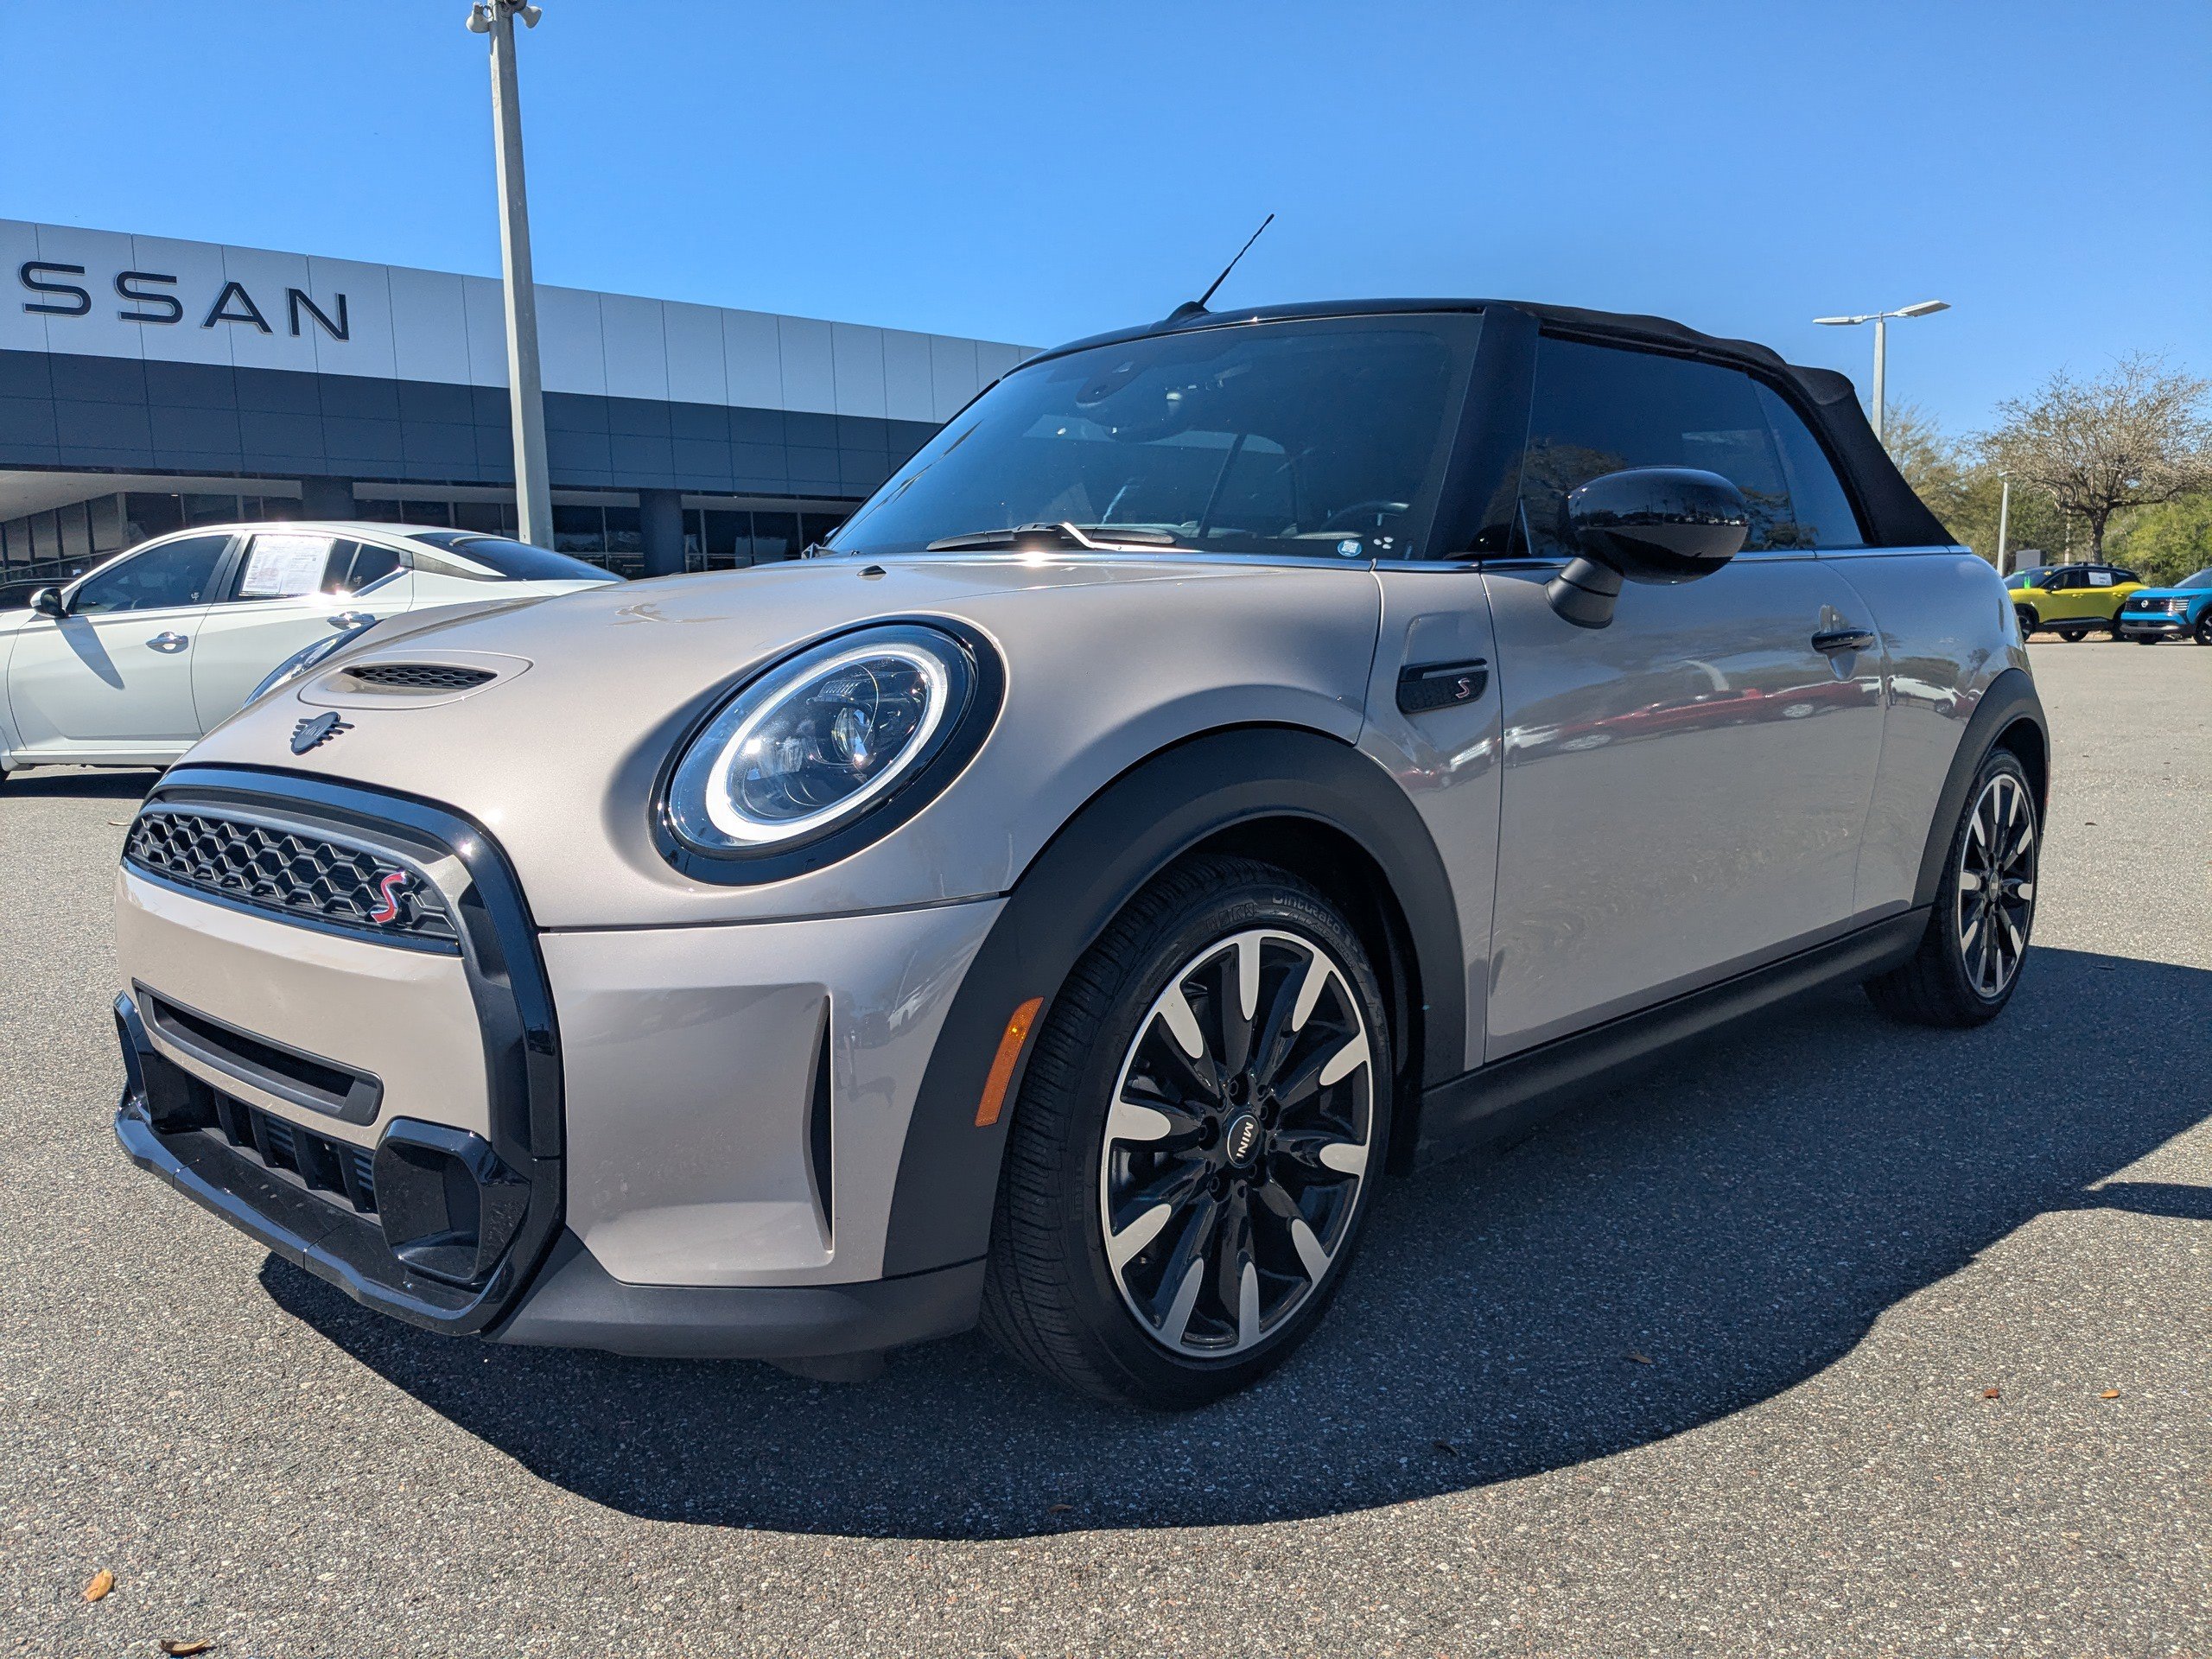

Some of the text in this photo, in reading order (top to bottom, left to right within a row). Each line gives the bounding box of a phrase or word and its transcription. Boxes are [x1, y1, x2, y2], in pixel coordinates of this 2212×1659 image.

[1455, 677, 1470, 699] S
[371, 871, 406, 924] S
[1236, 1122, 1254, 1158] MINI
